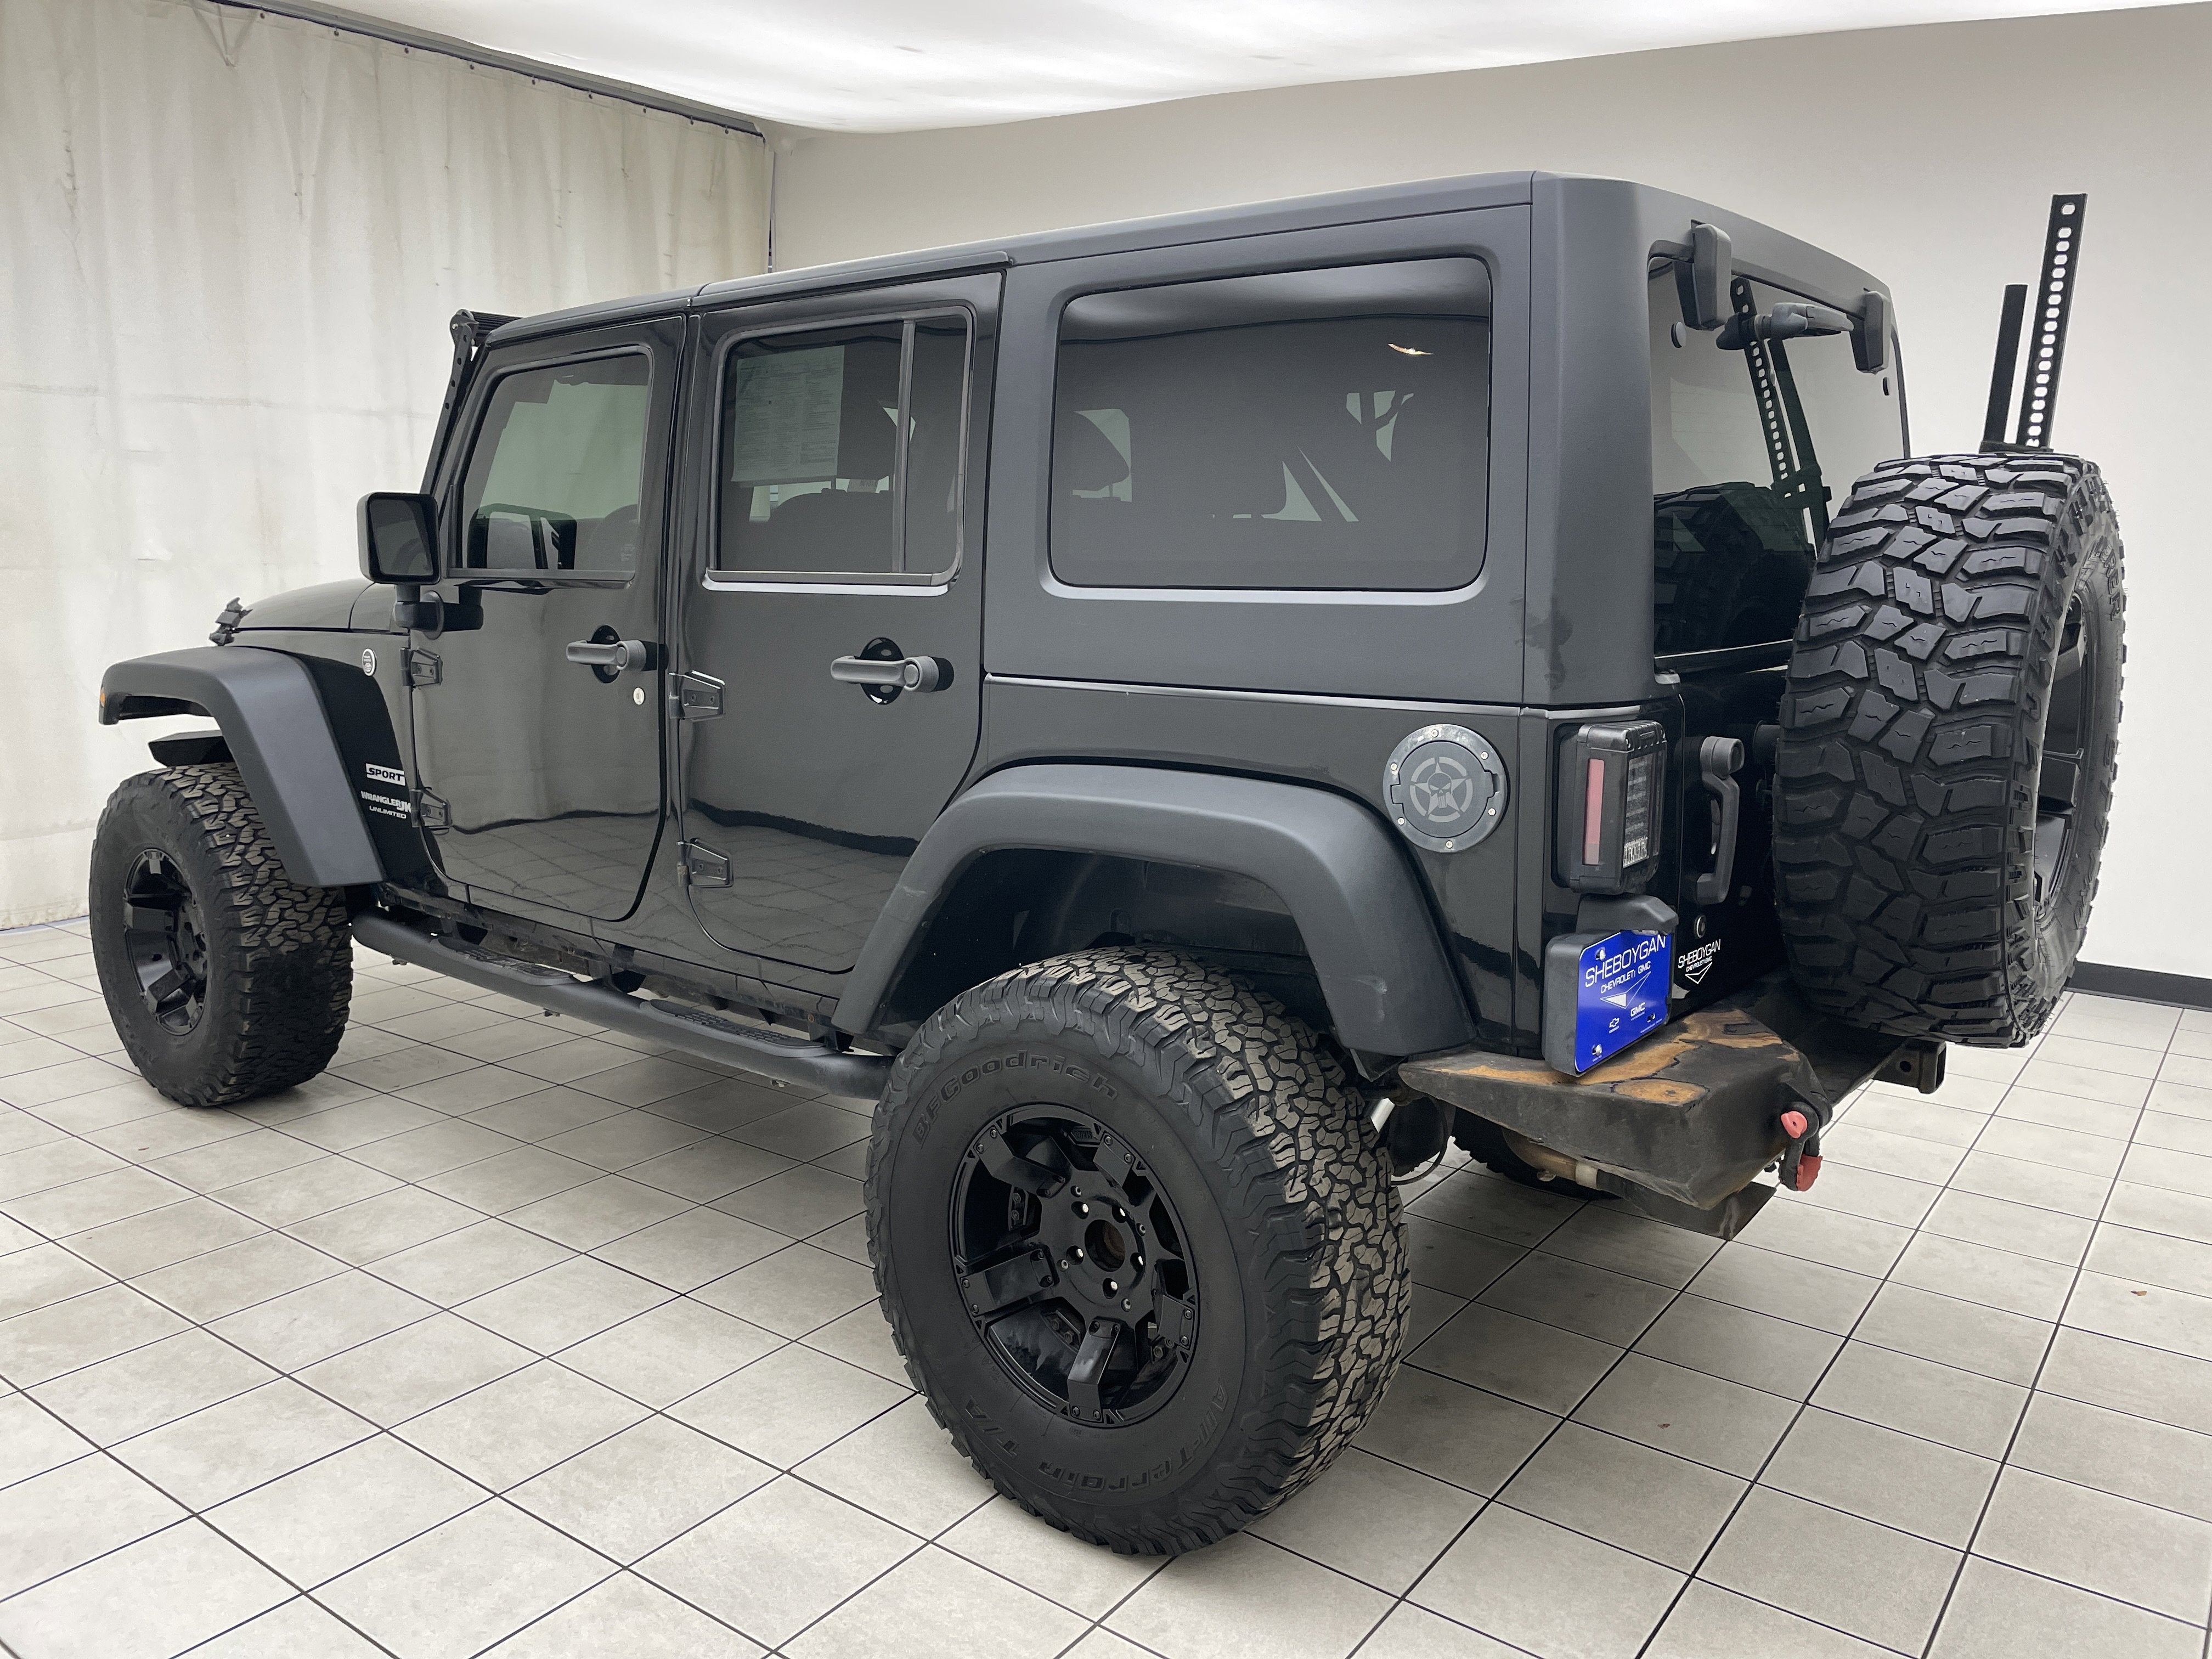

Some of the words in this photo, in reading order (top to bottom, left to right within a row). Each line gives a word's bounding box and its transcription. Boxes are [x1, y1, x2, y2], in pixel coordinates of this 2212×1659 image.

[367, 768, 404, 782] SPORT
[369, 805, 407, 819] UNLIMITED
[1585, 934, 1666, 988] SHEBOYGAN
[1678, 939, 1721, 969] SHEBOYGAN
[1600, 969, 1634, 994] CHEVROLET
[1638, 961, 1651, 974] GMC
[1630, 1002, 1646, 1017] GMC
[912, 1049, 1119, 1150] BFGoodrich
